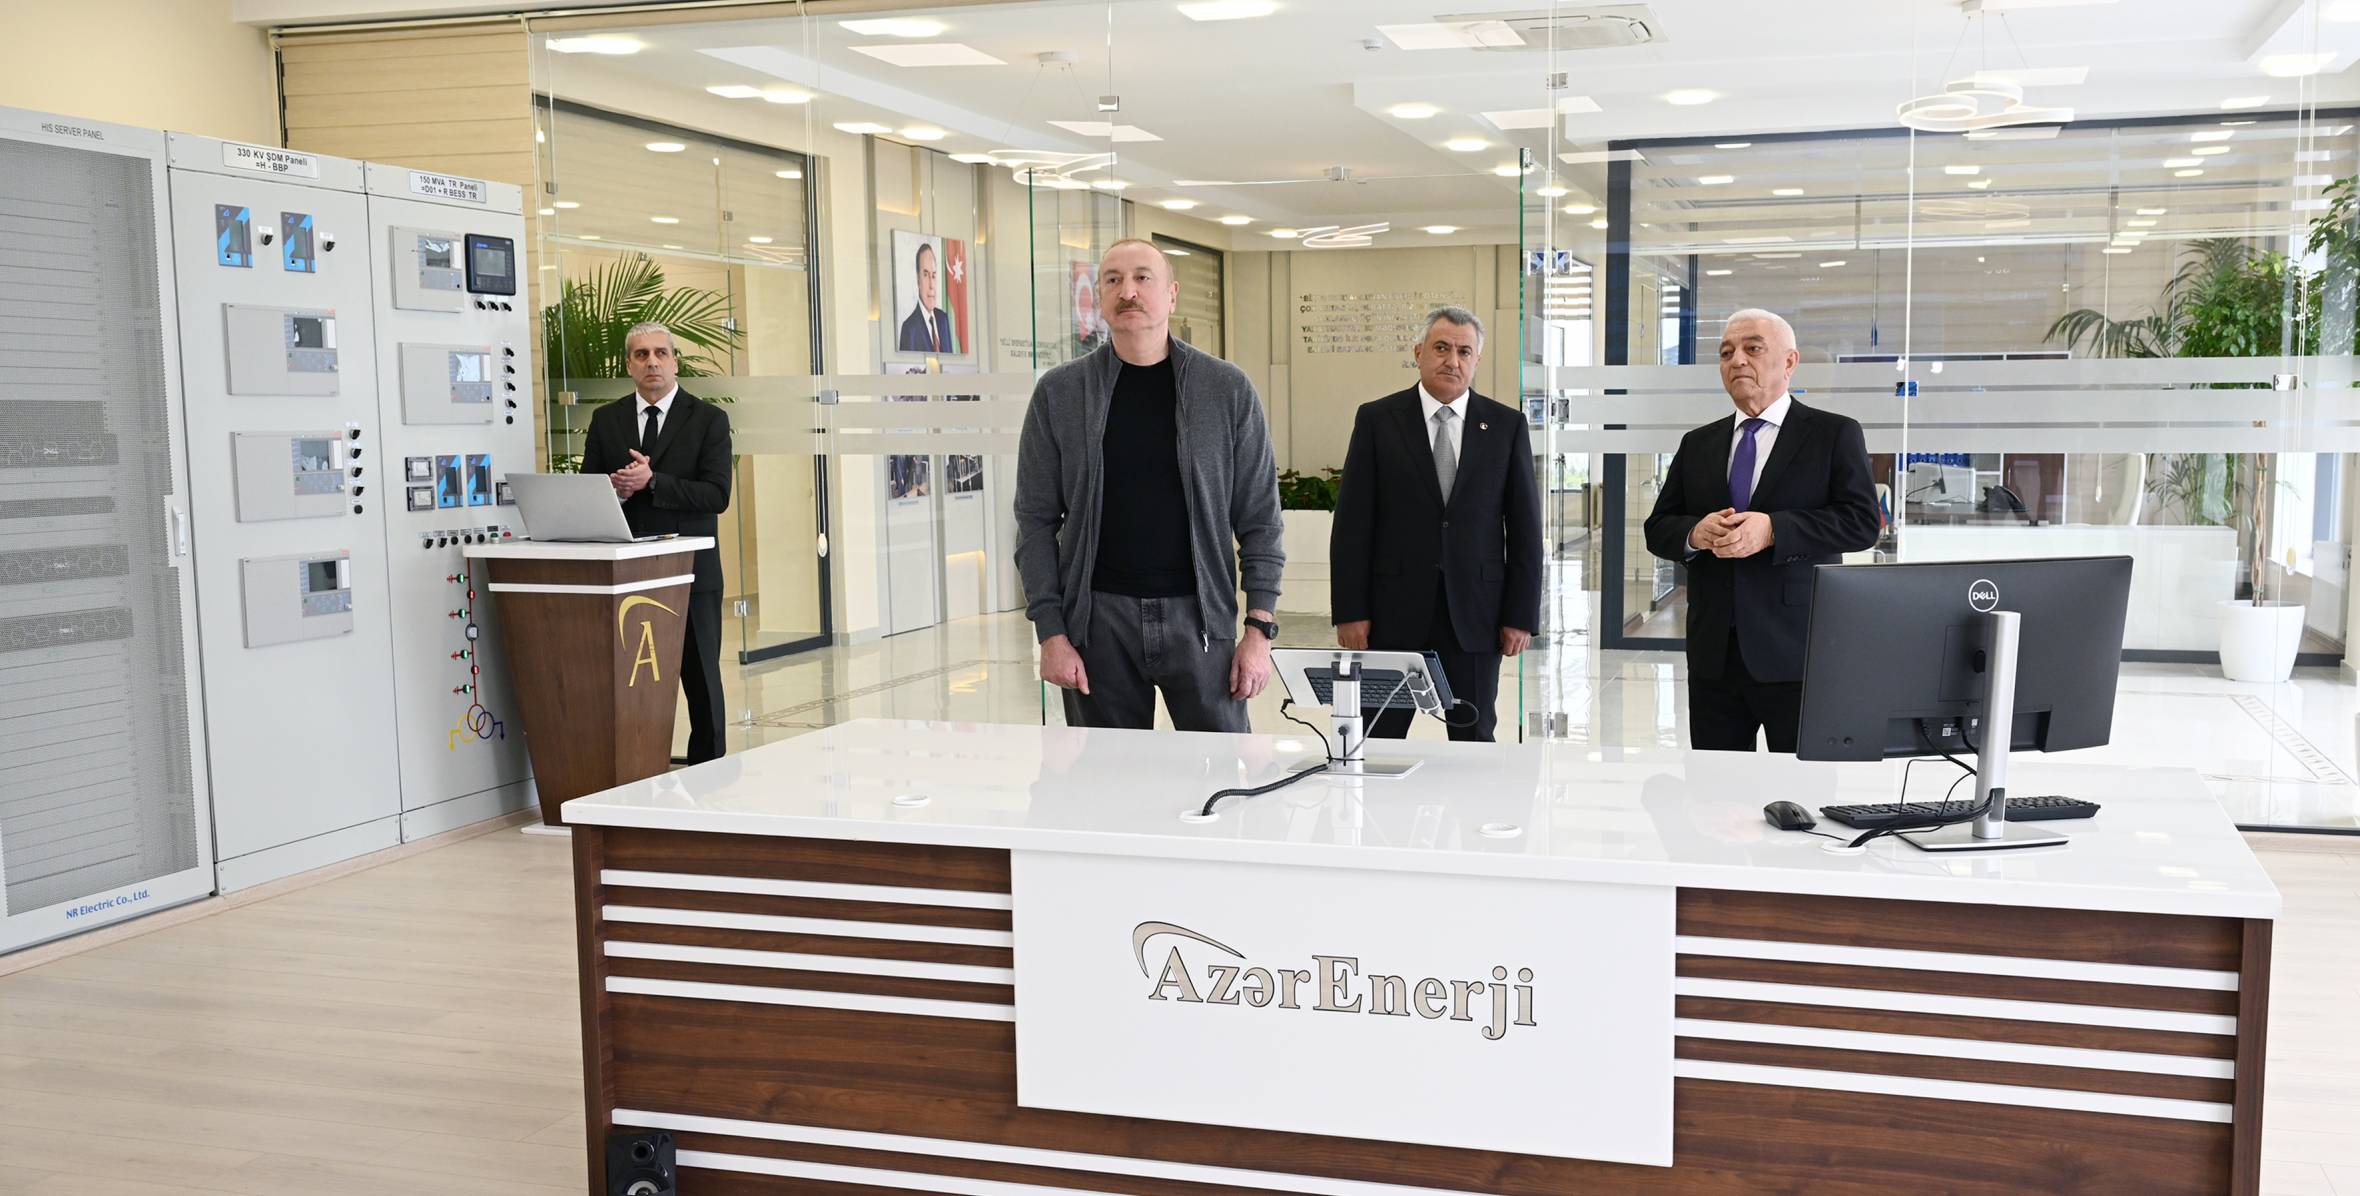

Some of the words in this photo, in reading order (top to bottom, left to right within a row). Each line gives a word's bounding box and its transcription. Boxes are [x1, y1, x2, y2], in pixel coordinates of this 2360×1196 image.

[54, 124, 81, 137] SERVER
[82, 128, 104, 141] PANEL
[237, 147, 251, 157] 330
[253, 150, 265, 160] KV
[285, 154, 308, 167] Paneli
[272, 162, 289, 172] BBP
[419, 175, 431, 185] 150
[431, 177, 446, 186] MVA
[448, 179, 457, 188] TR
[459, 181, 478, 192] Paneli
[468, 191, 478, 200] TR
[1972, 591, 1996, 600] DELL
[65, 908, 79, 919] NR
[79, 899, 115, 915] Electric
[133, 889, 151, 901] Ltd.
[1147, 944, 1538, 1041] AzərEnerji
